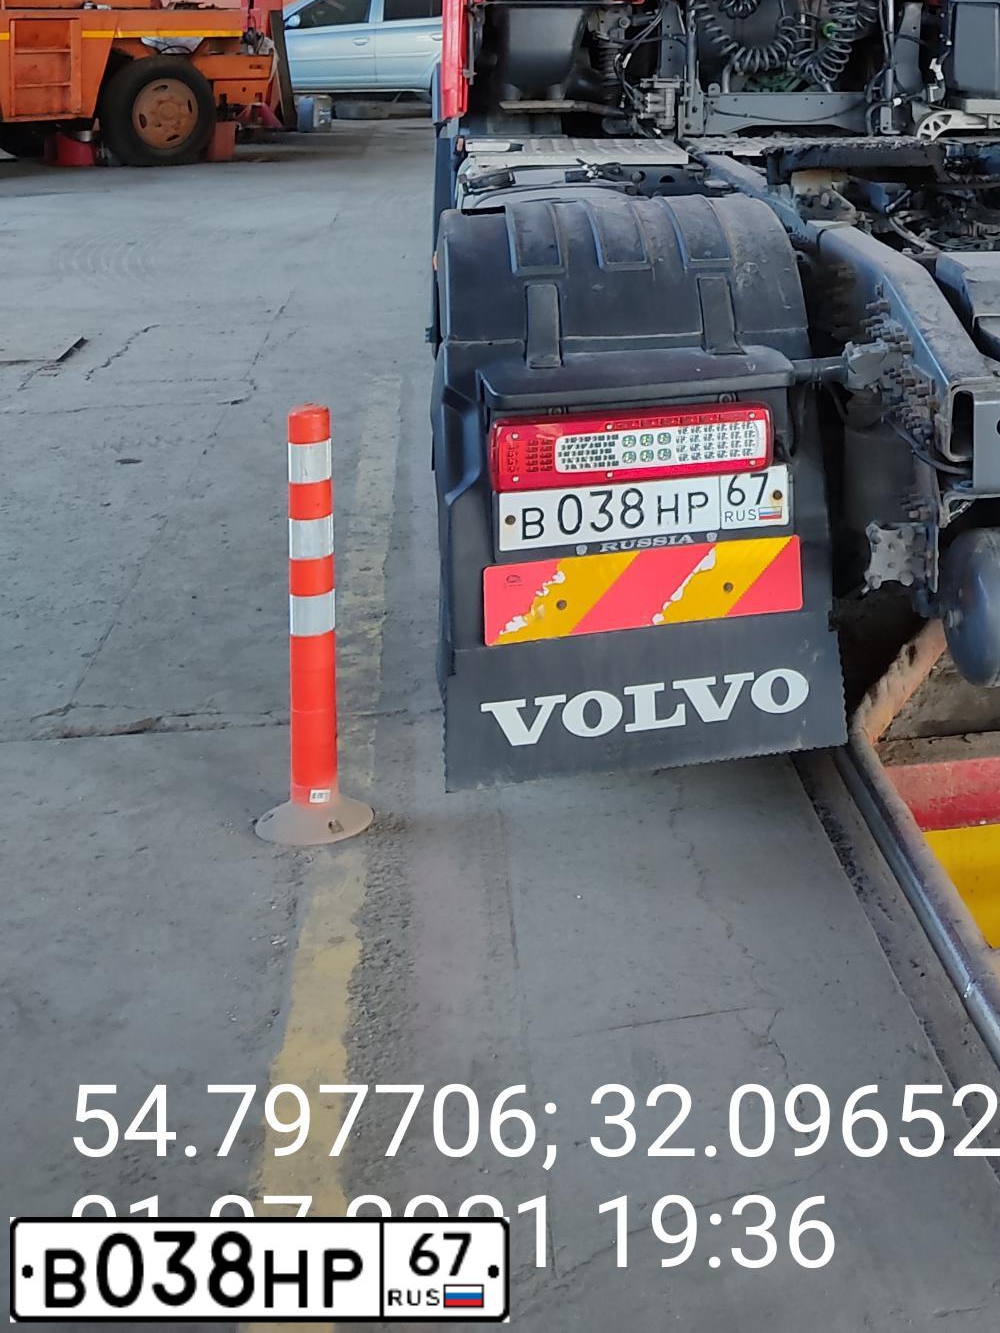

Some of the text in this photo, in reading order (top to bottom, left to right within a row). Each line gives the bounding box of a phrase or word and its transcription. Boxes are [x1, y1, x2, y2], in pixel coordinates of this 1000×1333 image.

[726, 472, 769, 508] 67
[723, 508, 757, 524] RUS
[600, 533, 695, 553] RUSSIA
[480, 668, 810, 747] VOLVO
